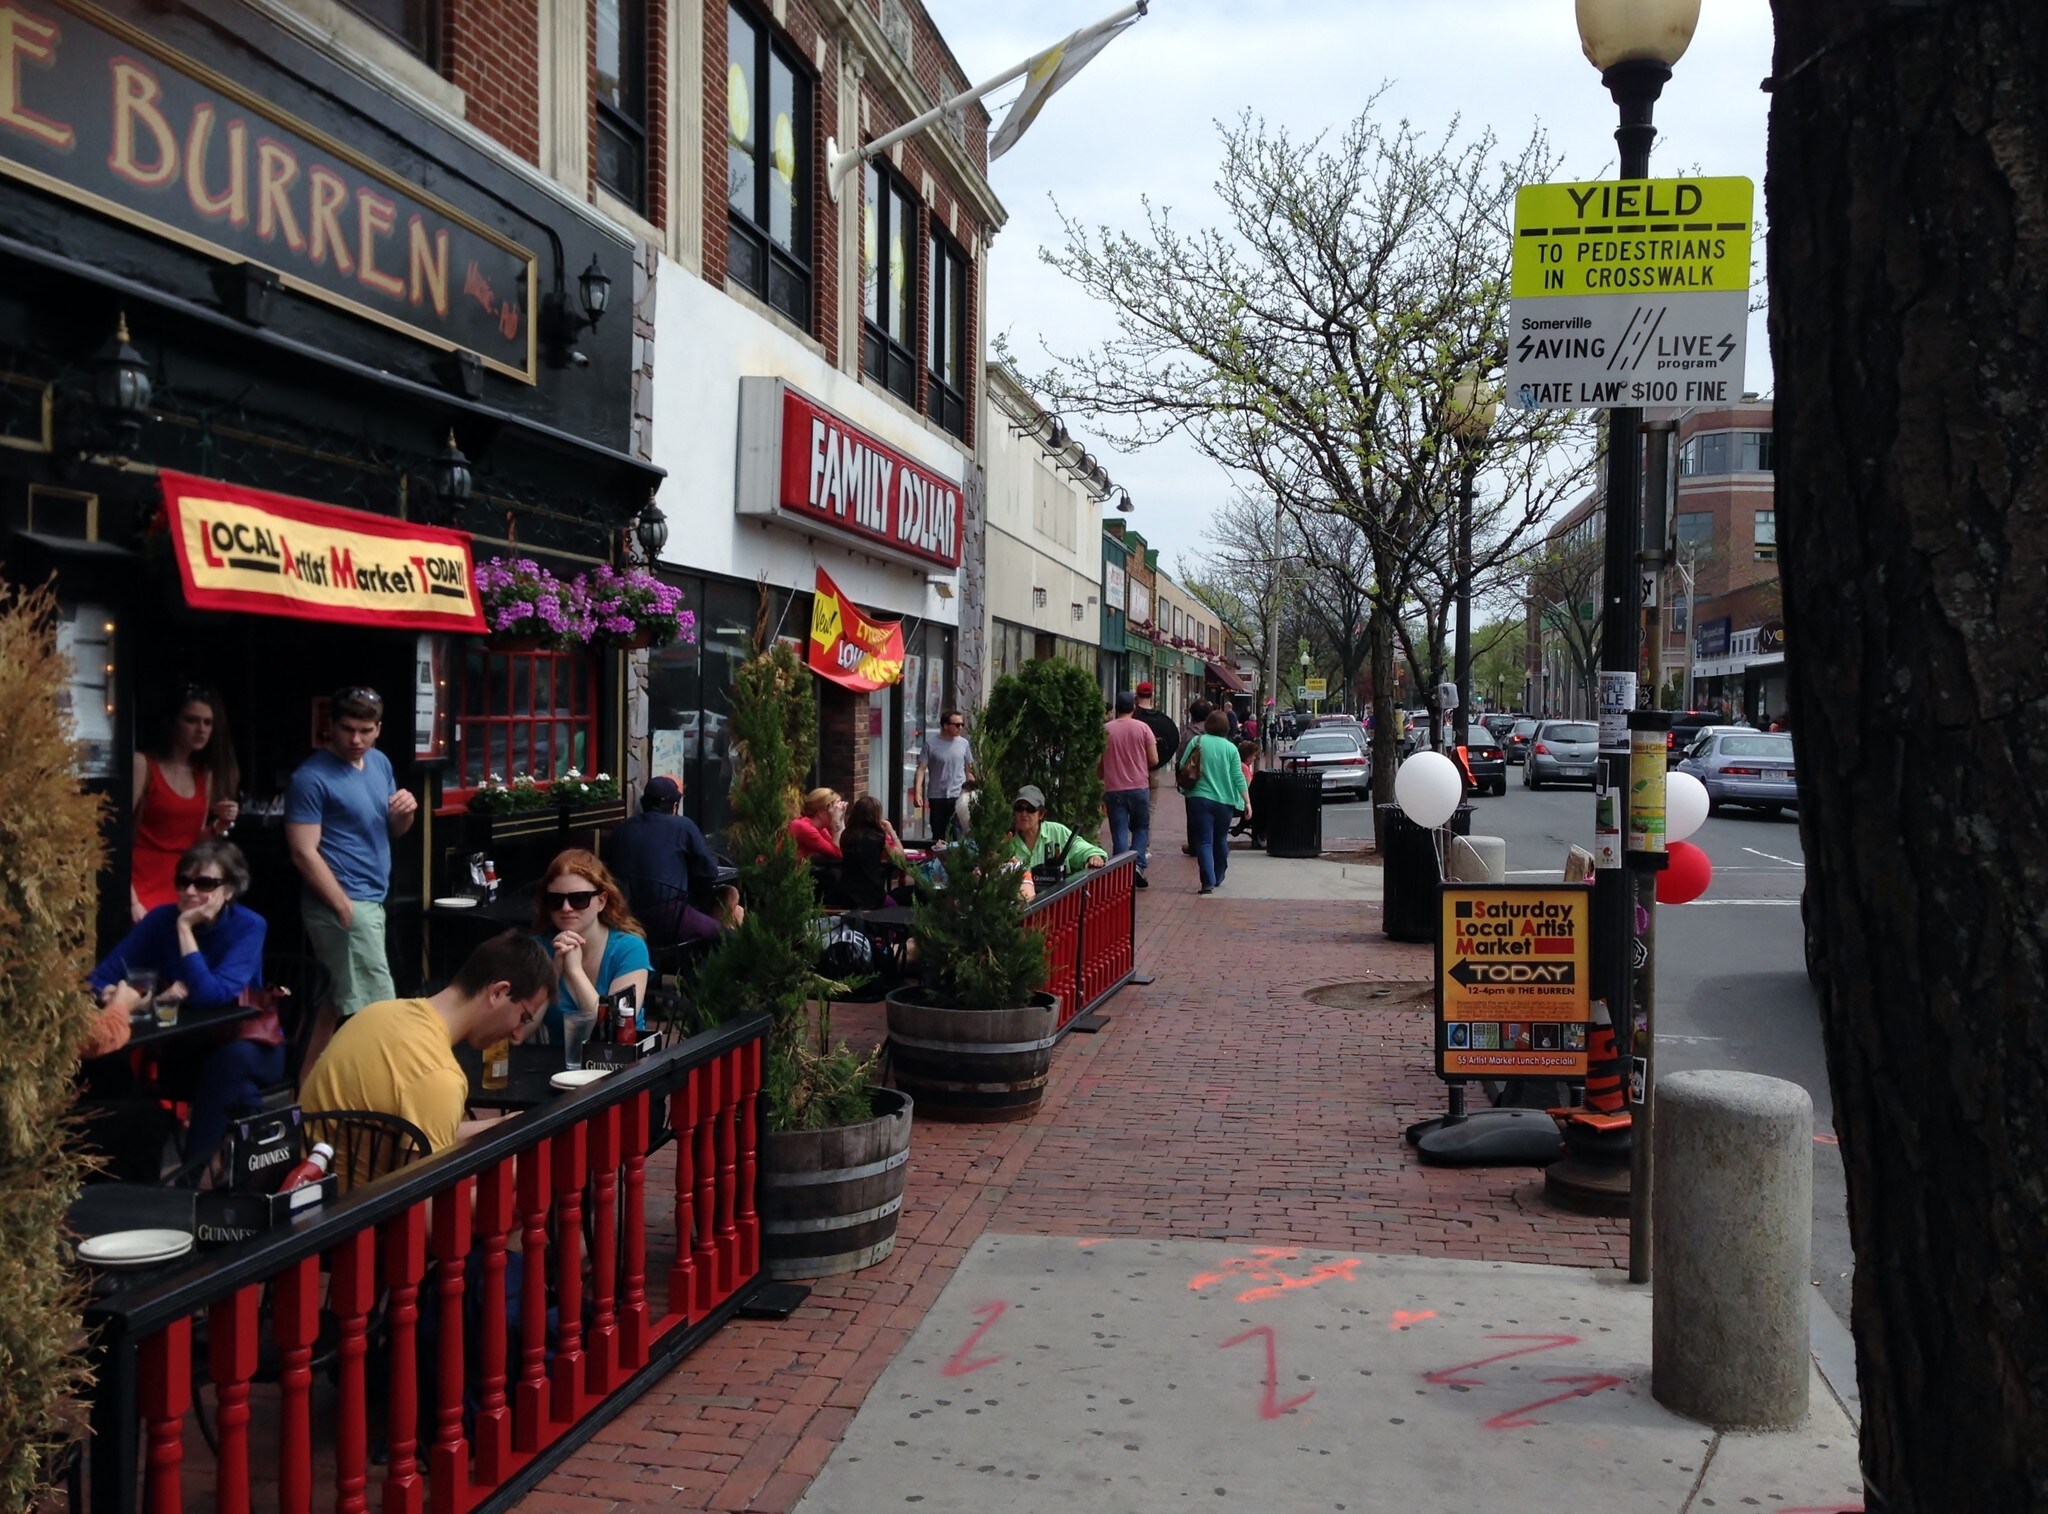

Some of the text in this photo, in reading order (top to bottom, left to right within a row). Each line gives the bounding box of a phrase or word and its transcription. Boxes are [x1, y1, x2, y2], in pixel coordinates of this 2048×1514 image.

[108, 56, 448, 316] BURREN
[1567, 184, 1702, 219] YIELD
[1538, 239, 1726, 264] TO PEDESTRIANS
[1544, 266, 1714, 289] IN CROSSWALK
[1521, 317, 1592, 330] Somerville
[1516, 333, 1736, 362] SAVING LIVES
[1657, 359, 1717, 370] program
[1581, 382, 1621, 402] LAW
[1631, 381, 1677, 401] $100
[1686, 381, 1727, 401] FINE
[808, 416, 957, 559] FAMILY DOLLAR
[200, 520, 280, 568] LOCAL
[280, 534, 328, 586] Artist
[330, 545, 416, 593] Market
[813, 598, 838, 636] New!
[1299, 688, 1306, 697] P
[1475, 900, 1574, 921] Saturday
[1456, 919, 1574, 936] Local Artist
[1455, 937, 1531, 955] Market
[1469, 964, 1568, 981] TODAY
[1468, 987, 1575, 996] 12-4pm @ THE BURREN
[1468, 1056, 1487, 1064] Artist
[1489, 1056, 1515, 1065] Market
[1517, 1056, 1540, 1065] Lunch
[1541, 1056, 1576, 1066] Specials!
[248, 1148, 290, 1171] GUINNESS
